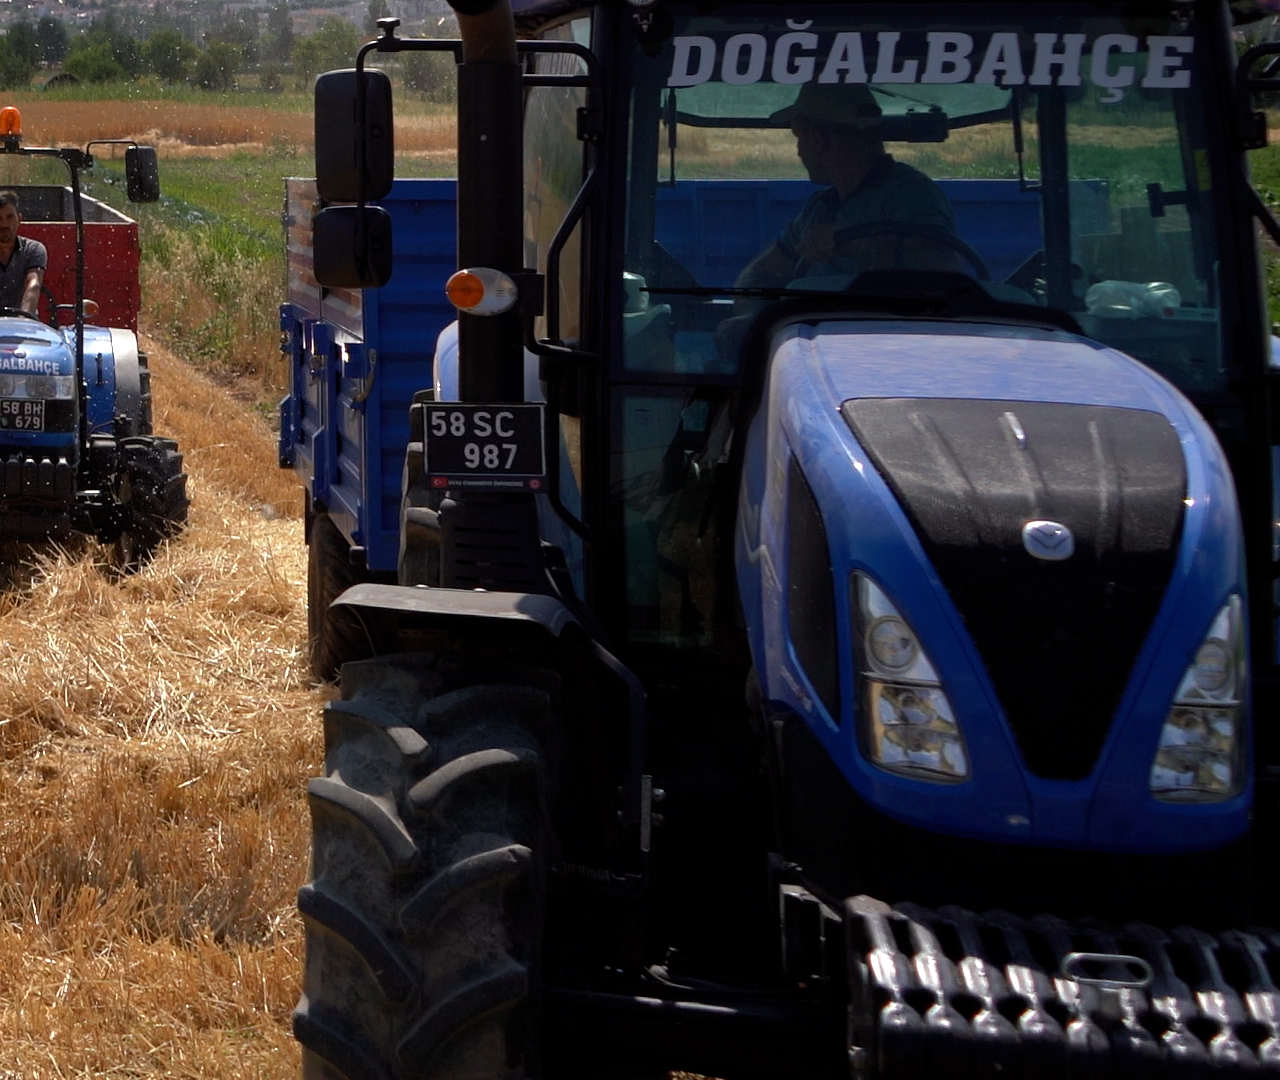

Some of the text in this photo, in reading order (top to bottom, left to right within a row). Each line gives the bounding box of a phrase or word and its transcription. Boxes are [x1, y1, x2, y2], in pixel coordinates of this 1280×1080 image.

[667, 18, 1195, 104] DOĞALBAHÇE
[2, 401, 42, 415] 58 BH
[15, 416, 41, 429] 679
[431, 411, 515, 438] 58 SC
[464, 442, 518, 470] 987
